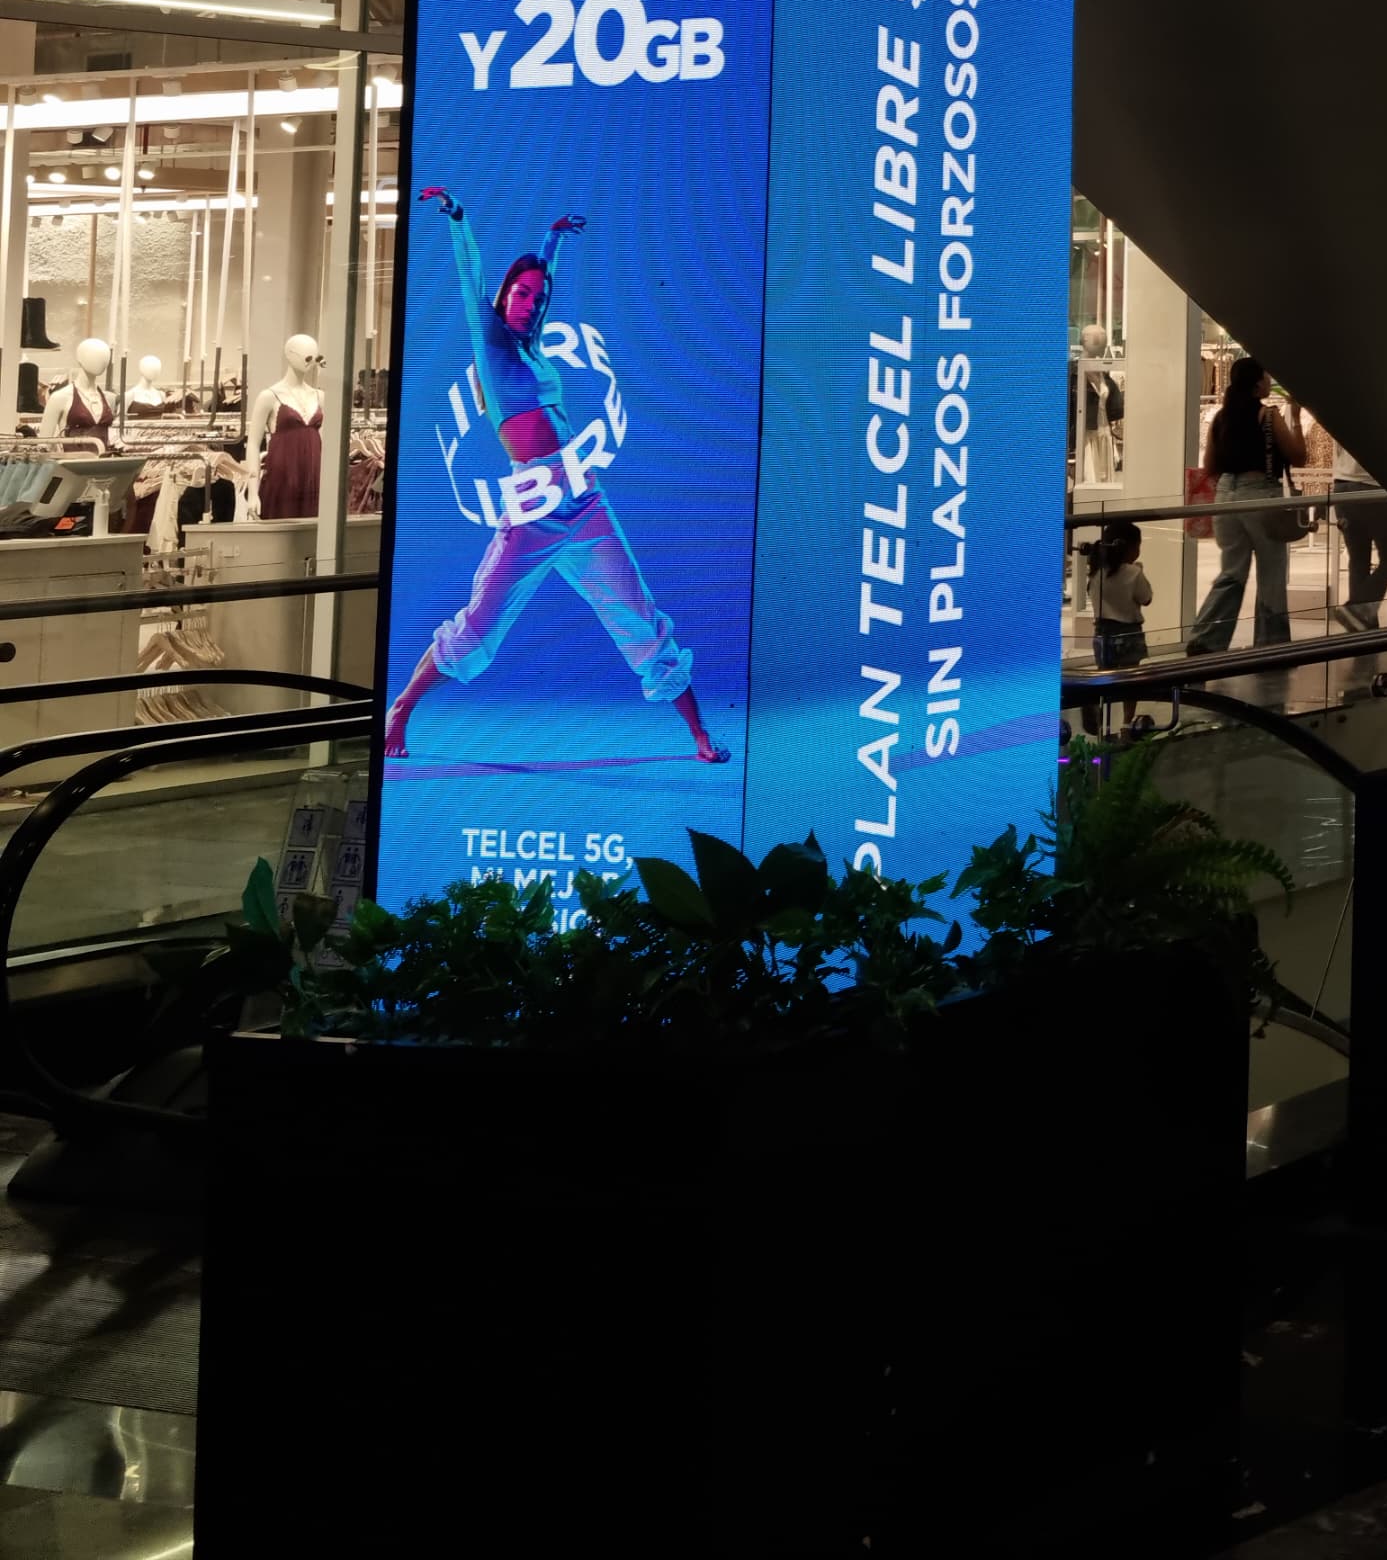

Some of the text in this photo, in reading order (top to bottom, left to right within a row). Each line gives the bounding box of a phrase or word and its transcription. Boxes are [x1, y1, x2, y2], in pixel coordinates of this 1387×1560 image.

[871, 24, 921, 284] LIBRE
[859, 316, 913, 635] TELCEL
[929, 353, 972, 623] PLAZOS
[852, 663, 903, 890] PLAN
[924, 646, 964, 759] SIN
[462, 828, 635, 870] TELCEL 5G,
[512, 866, 622, 900] MEJR
